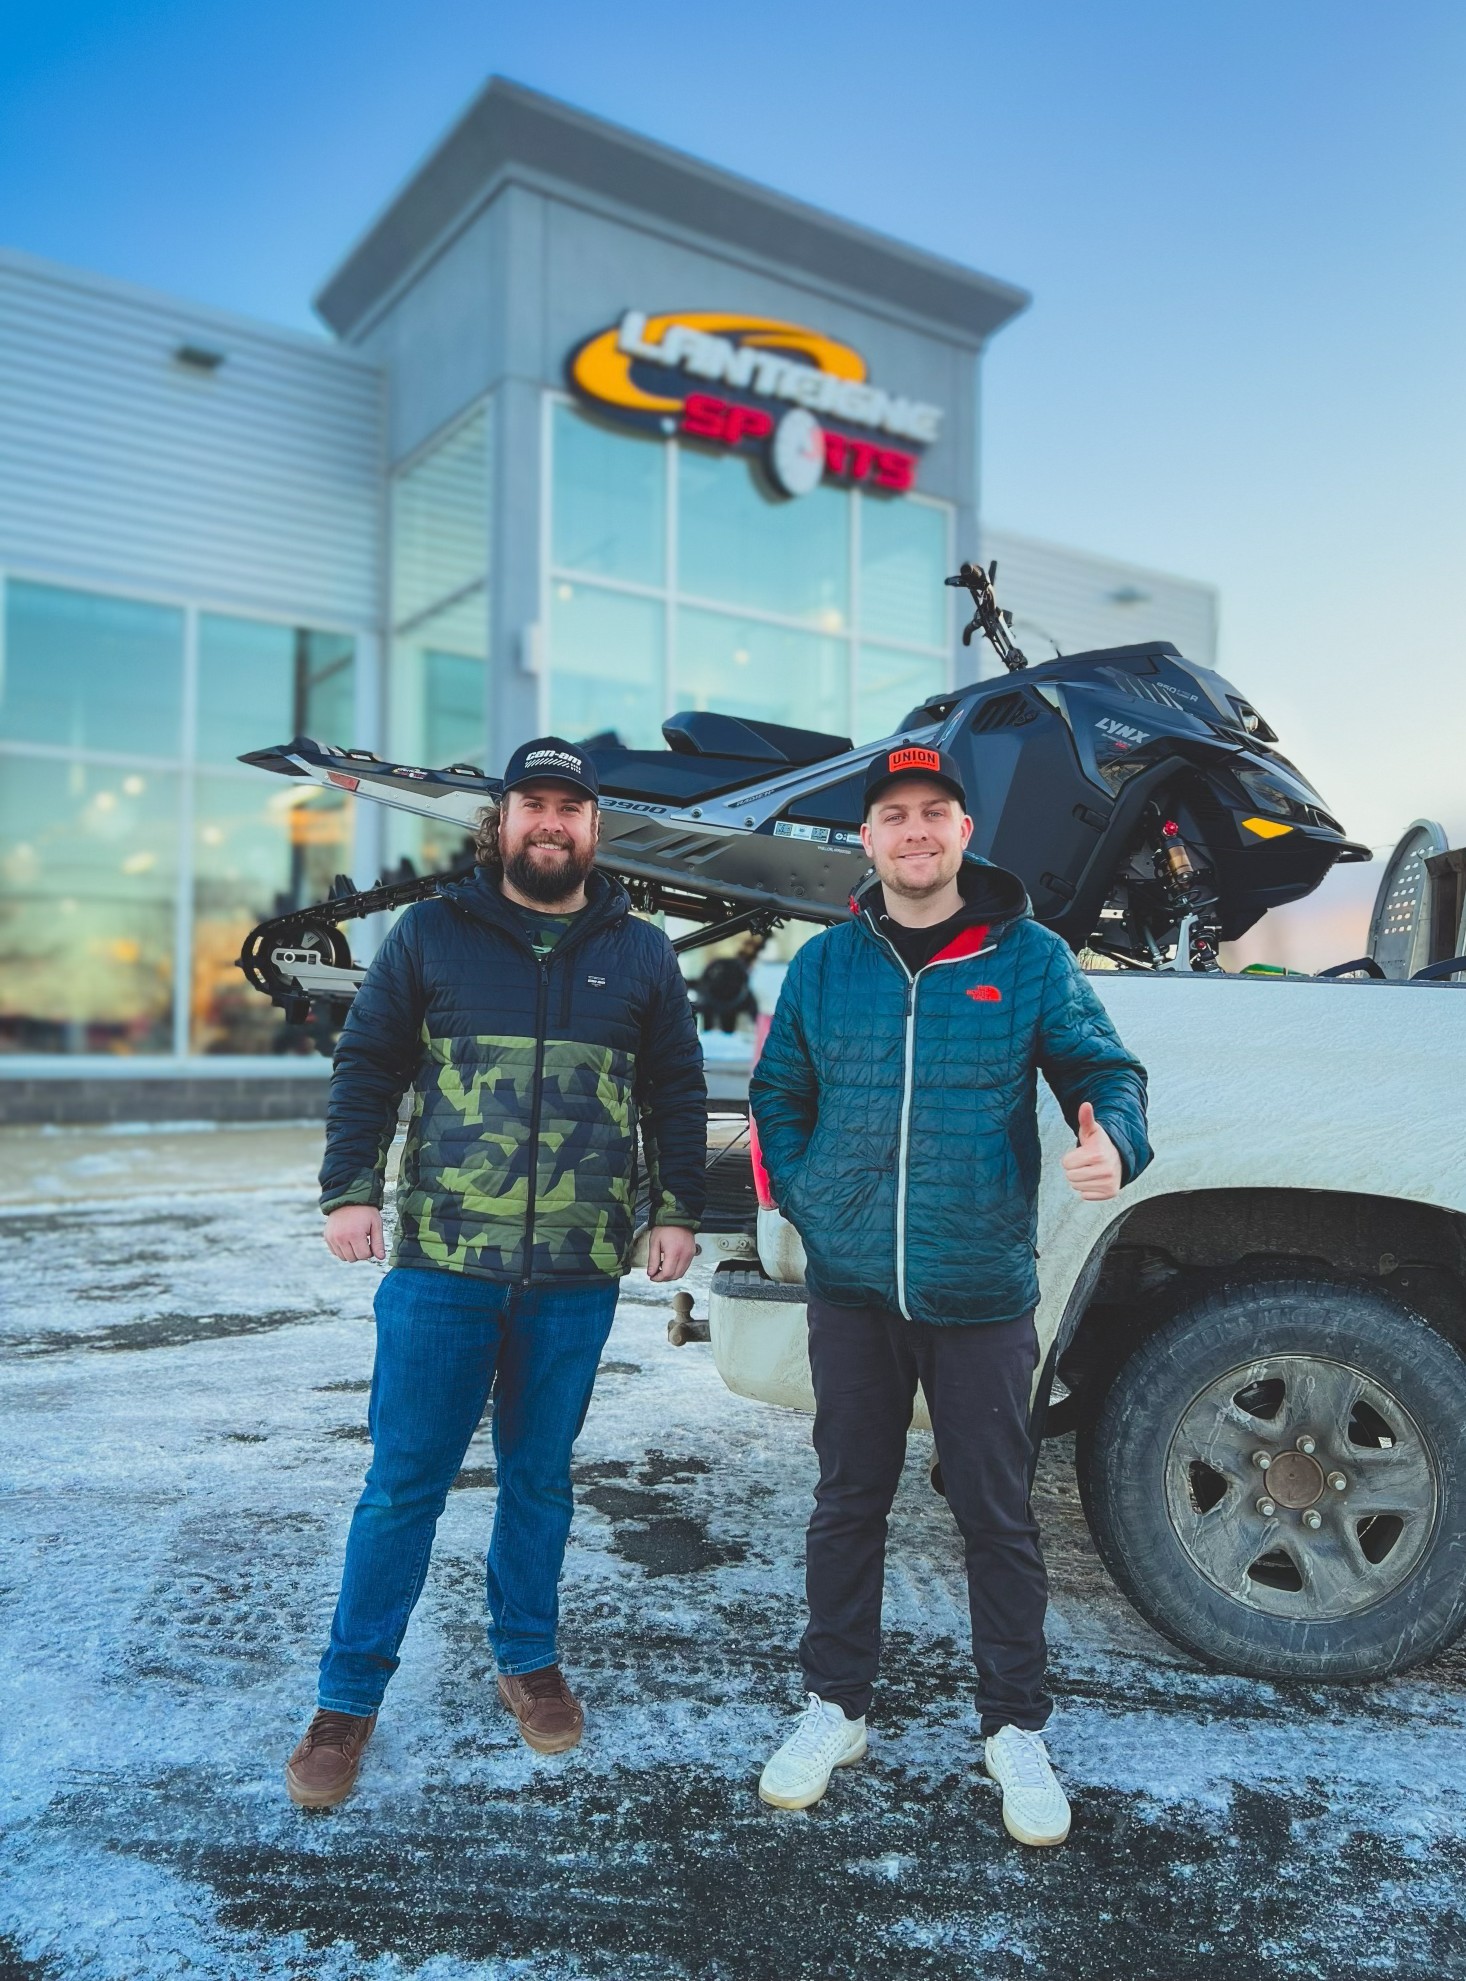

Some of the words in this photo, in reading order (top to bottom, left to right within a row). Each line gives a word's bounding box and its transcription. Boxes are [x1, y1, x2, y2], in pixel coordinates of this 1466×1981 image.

[617, 310, 943, 442] LANTEIGNE
[1094, 717, 1151, 744] LYNX
[893, 750, 936, 765] UNION
[599, 798, 667, 815] 3900
